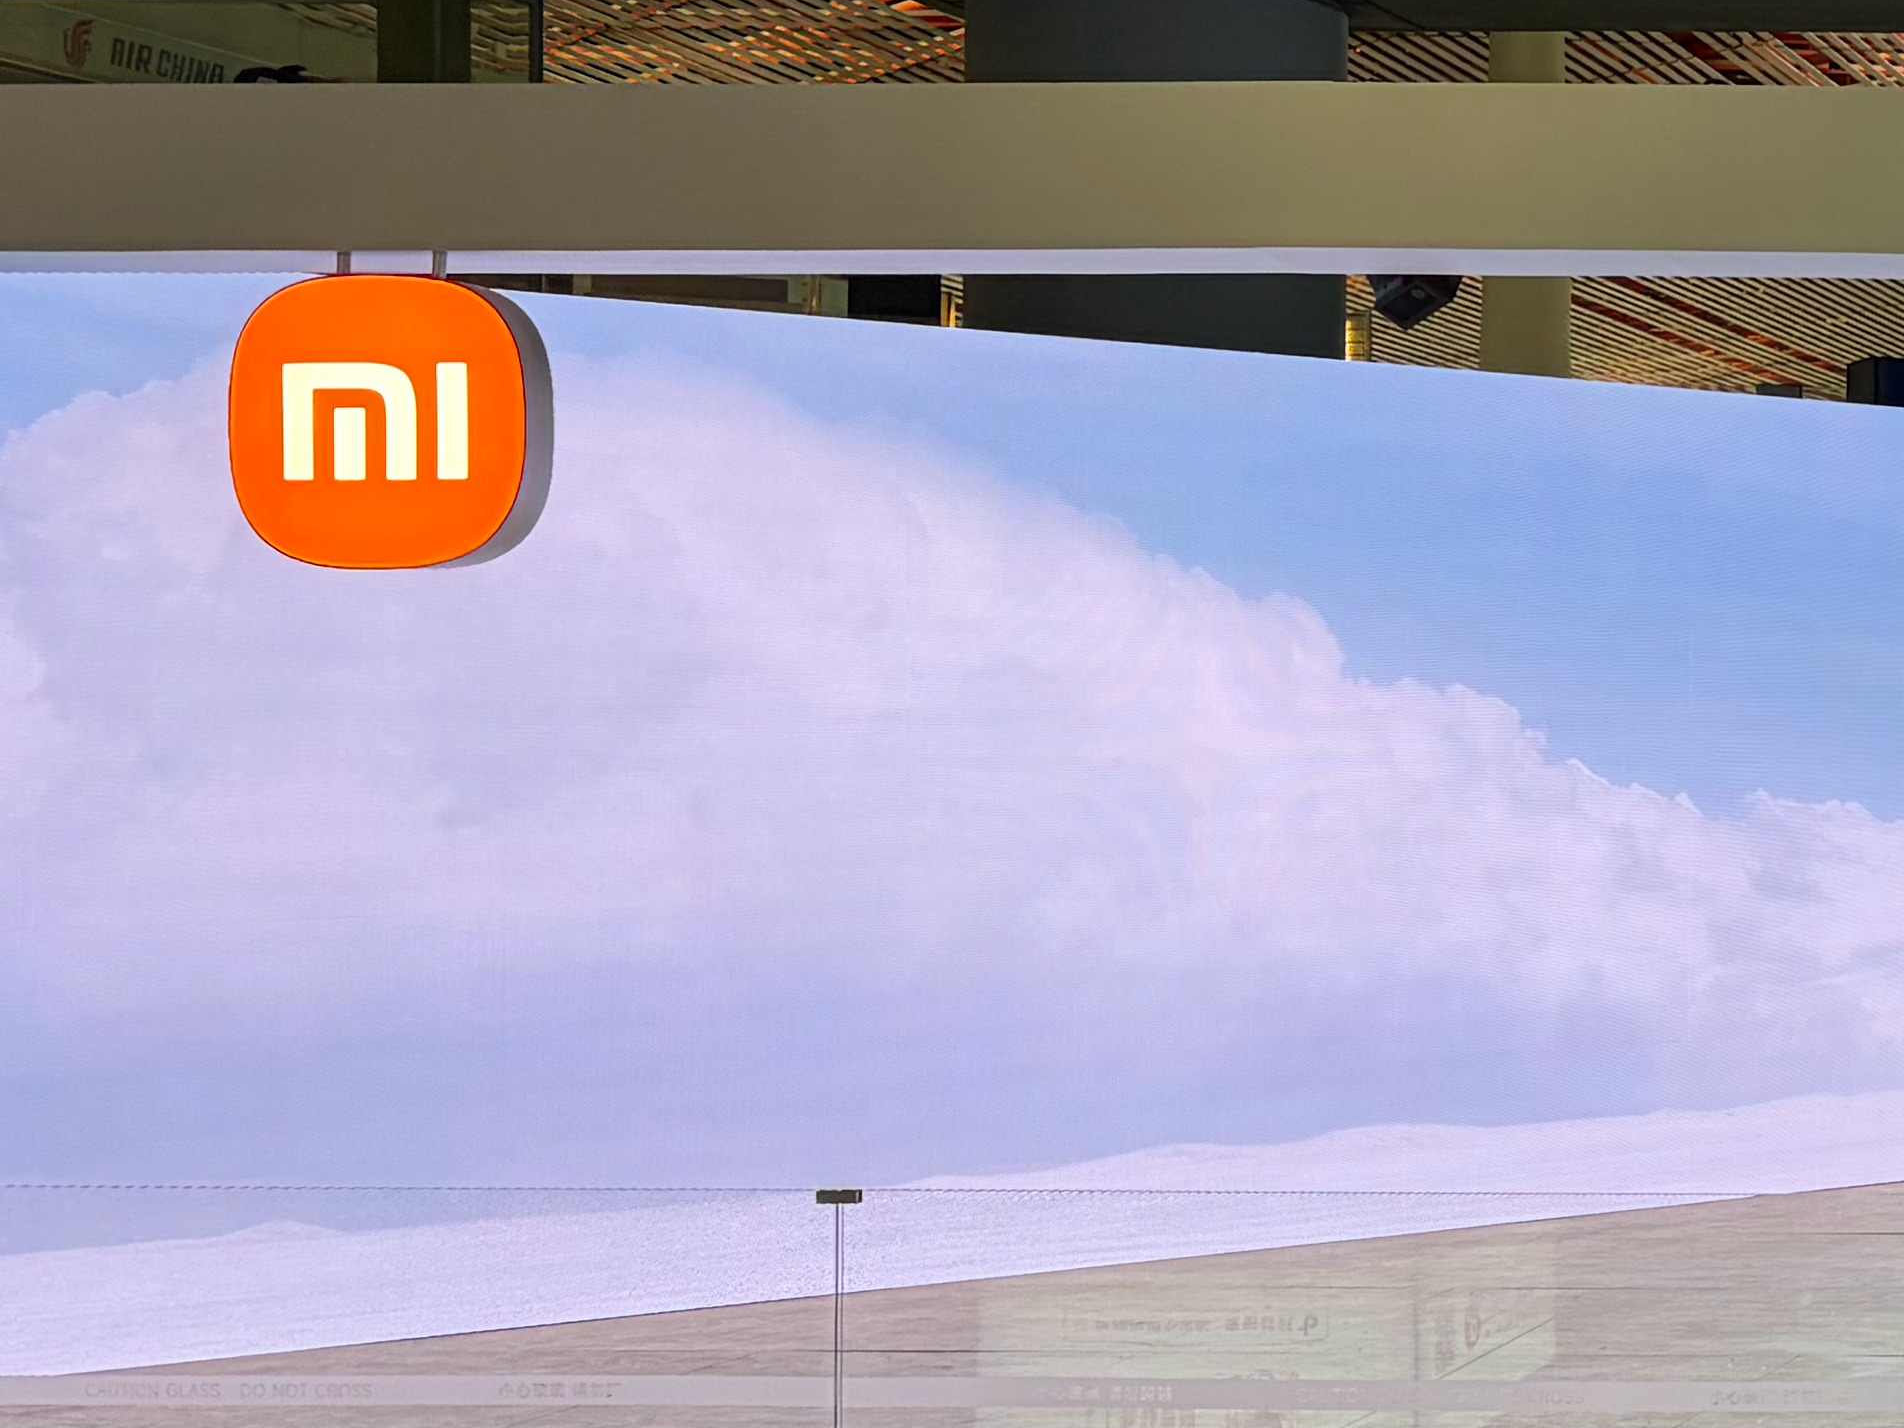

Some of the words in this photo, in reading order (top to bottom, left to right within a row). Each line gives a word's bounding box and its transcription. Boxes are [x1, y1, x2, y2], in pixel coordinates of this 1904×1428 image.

[110, 37, 152, 74] AIR
[156, 48, 225, 84] CHINA
[166, 1383, 221, 1399] GLASS
[240, 1383, 267, 1399] DO
[272, 1383, 307, 1399] NOT
[315, 1383, 372, 1399] CROSS
